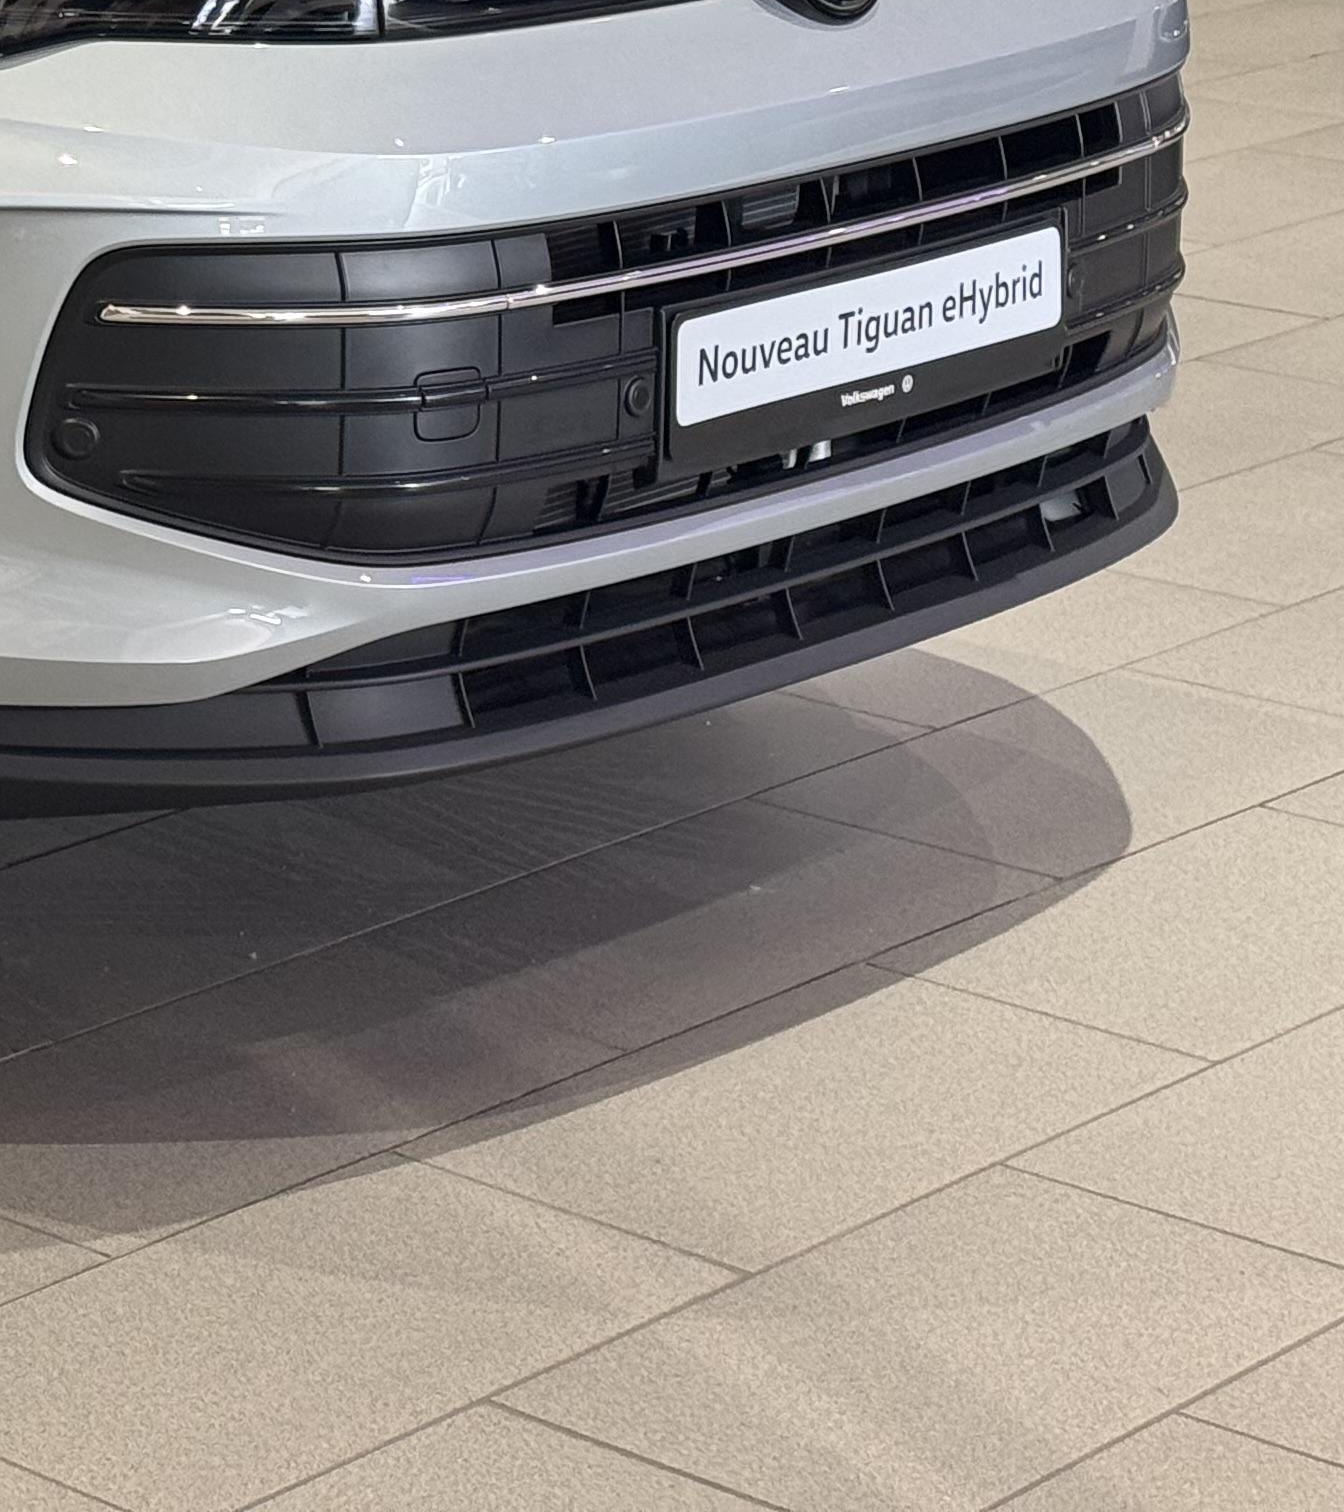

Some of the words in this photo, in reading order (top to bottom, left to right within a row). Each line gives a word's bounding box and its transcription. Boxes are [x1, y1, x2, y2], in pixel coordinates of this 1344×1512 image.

[698, 327, 830, 387] Nouveau
[838, 300, 933, 354] Tiguan
[942, 259, 1044, 324] eHybrid
[840, 384, 895, 407] Volkswagen
